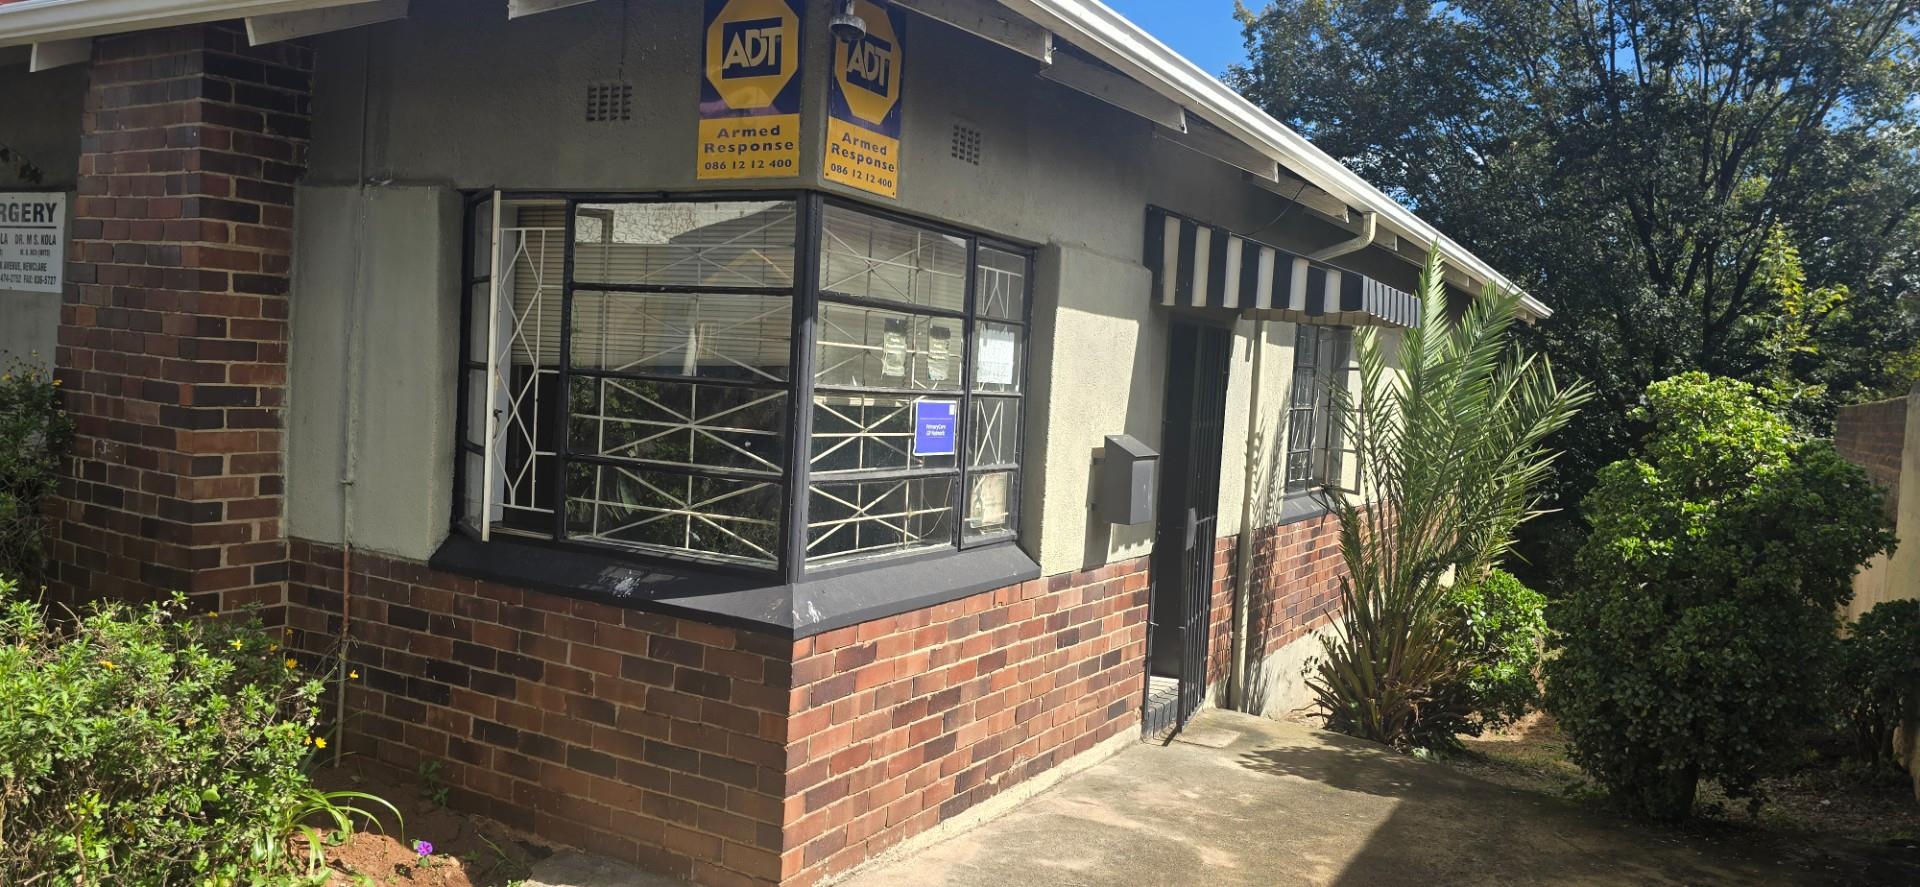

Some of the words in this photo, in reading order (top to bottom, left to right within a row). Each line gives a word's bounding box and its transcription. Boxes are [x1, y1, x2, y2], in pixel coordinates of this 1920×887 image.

[722, 26, 784, 70] ADT
[846, 37, 891, 87] ADT
[717, 125, 781, 139] Armed
[842, 132, 887, 156] Armed
[704, 141, 794, 155] Response
[831, 142, 895, 173] Response
[704, 162, 726, 171] 086
[732, 161, 745, 170] 12
[751, 160, 764, 169] 12
[769, 159, 792, 168] 400
[830, 163, 848, 176] 086
[852, 167, 862, 179] 12
[865, 172, 875, 183] 12
[877, 175, 892, 188] 400
[14, 233, 25, 245] DR.
[40, 234, 57, 245] KOLA
